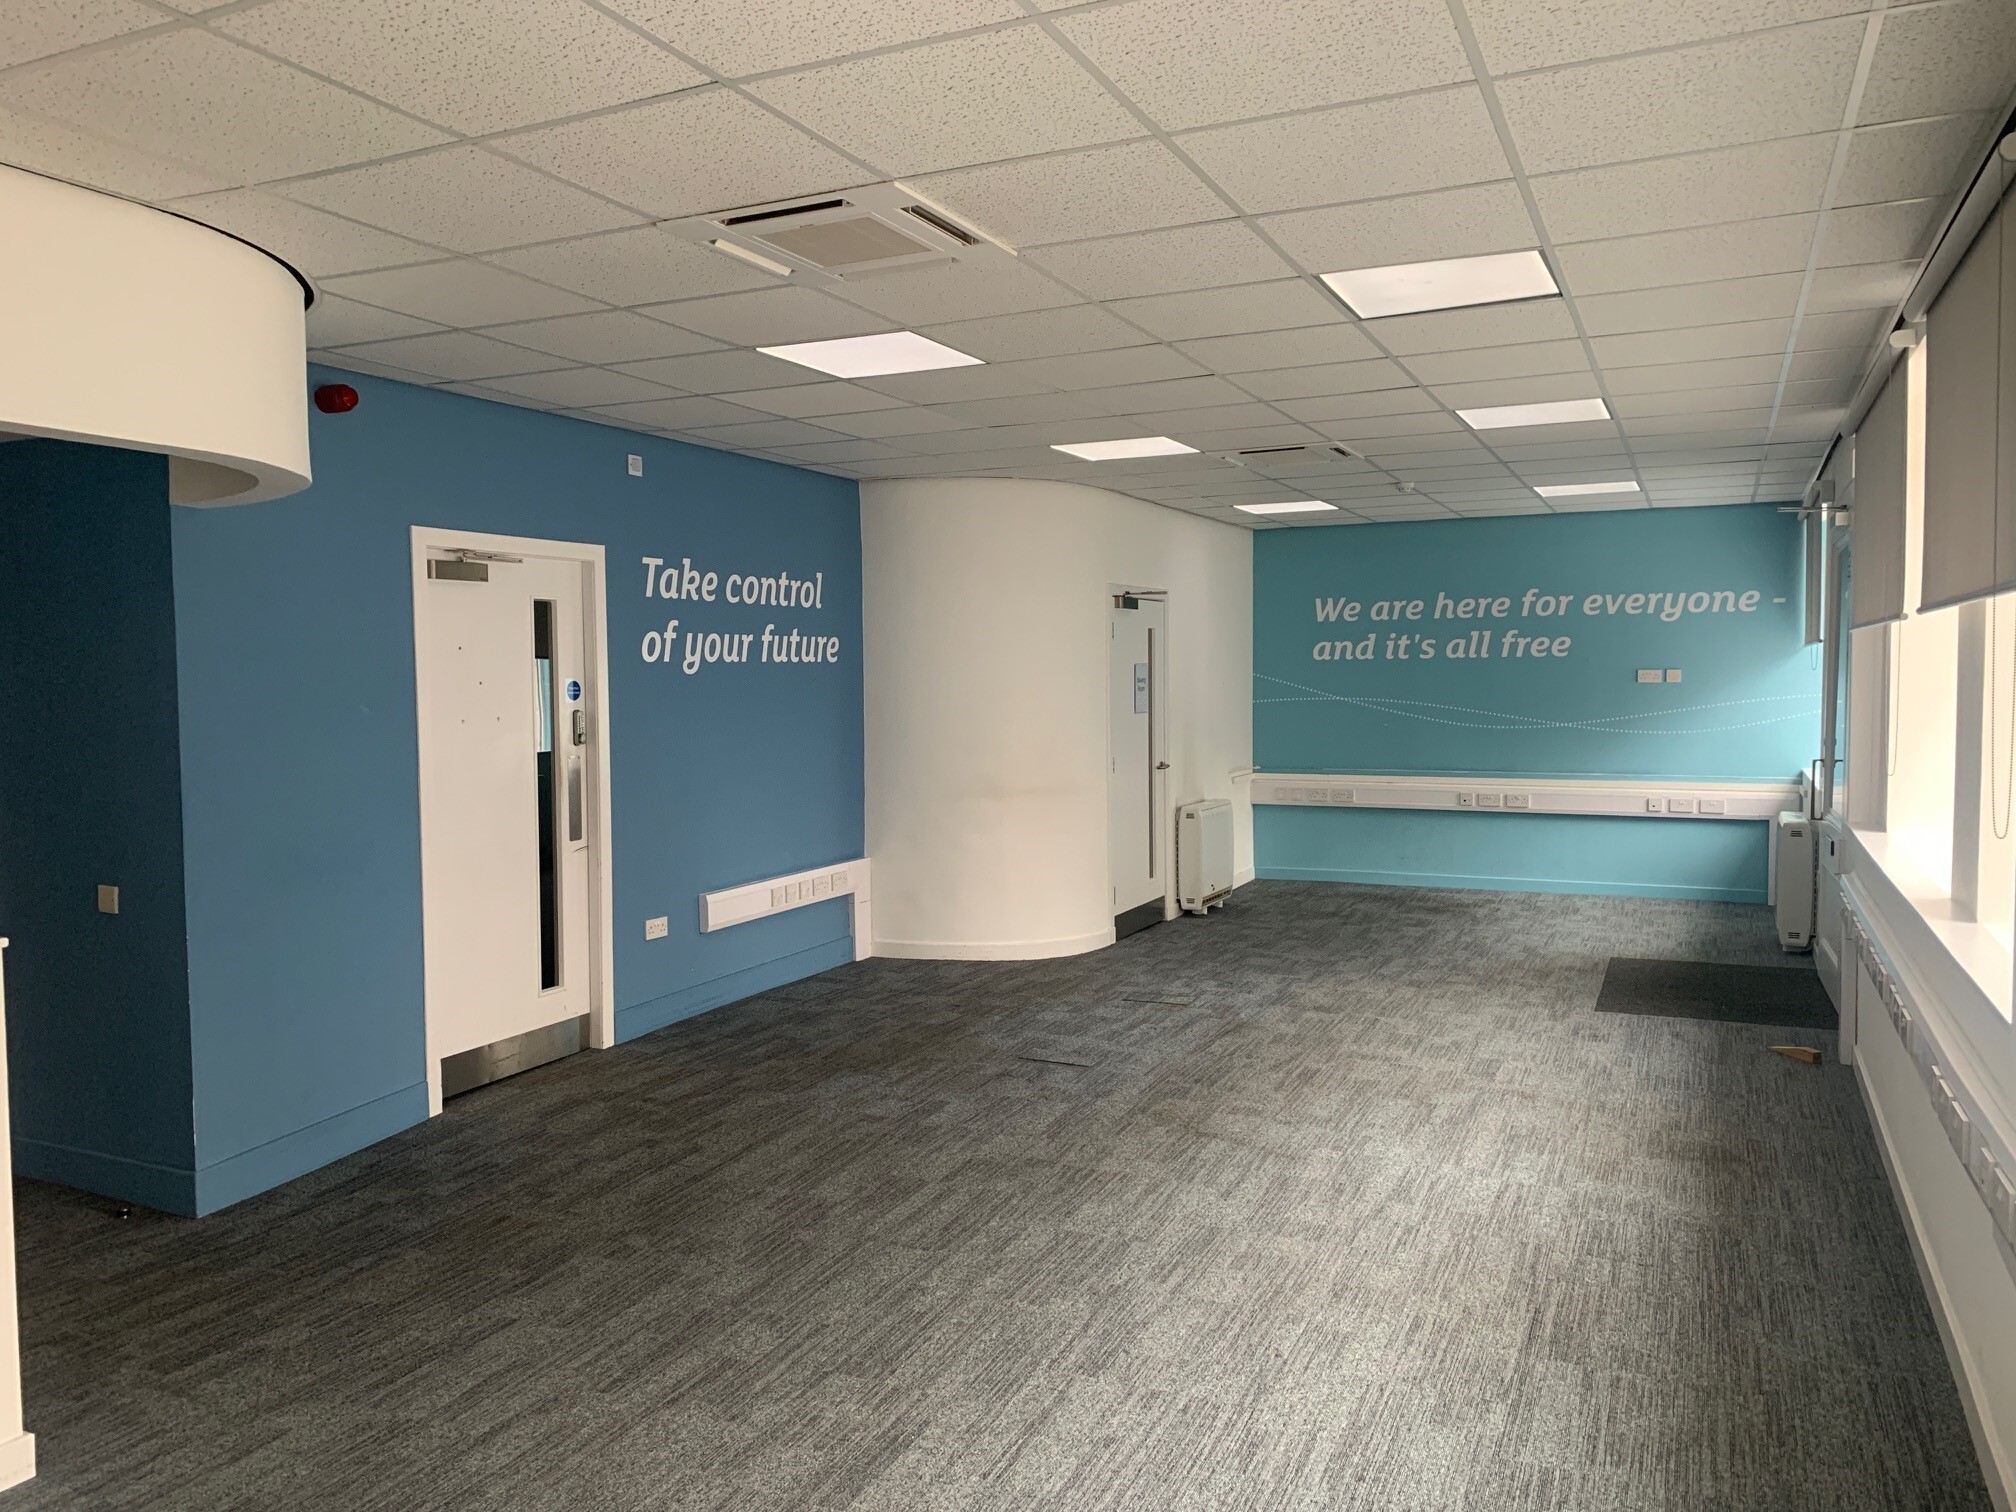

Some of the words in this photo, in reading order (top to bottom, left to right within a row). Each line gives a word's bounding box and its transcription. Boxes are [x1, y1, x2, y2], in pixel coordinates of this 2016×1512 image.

[641, 556, 719, 602] Take
[725, 571, 823, 610] control
[1315, 597, 1362, 623] We
[1370, 599, 1425, 621] are
[1434, 591, 1511, 619] here
[1520, 588, 1574, 618] for
[1582, 590, 1761, 622] everyone
[641, 619, 680, 663] of
[682, 632, 754, 675] your
[761, 623, 841, 664] future
[1312, 633, 1377, 661] and
[1385, 632, 1437, 660] it's
[1445, 630, 1492, 659] all
[1501, 629, 1572, 658] free
